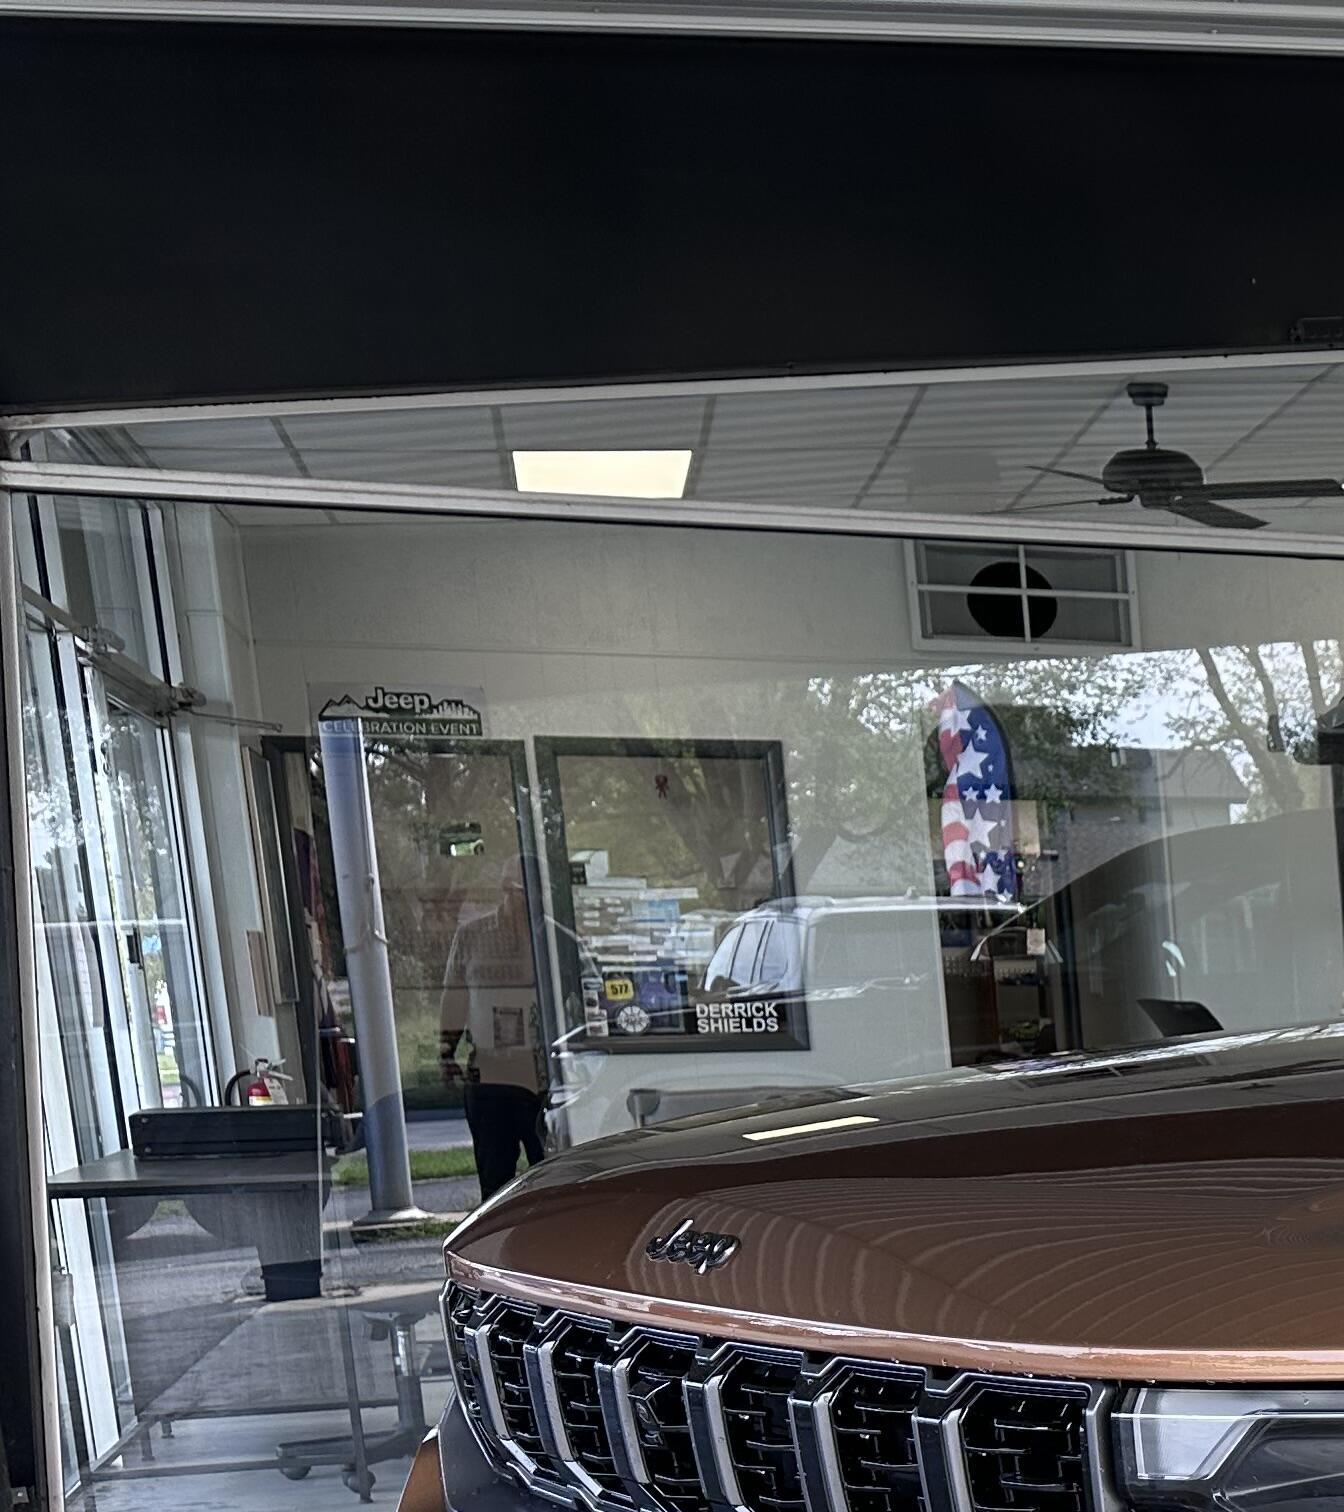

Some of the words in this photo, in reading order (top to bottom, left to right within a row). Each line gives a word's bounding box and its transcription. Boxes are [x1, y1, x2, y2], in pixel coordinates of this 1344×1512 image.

[366, 688, 432, 713] Jeep
[321, 720, 426, 735] CELBRATION
[431, 722, 478, 735] EVENT
[610, 983, 629, 995] 577
[696, 1003, 778, 1017] DERRICK
[697, 1018, 779, 1033] SHIELDS
[646, 1219, 741, 1275] Jeep
